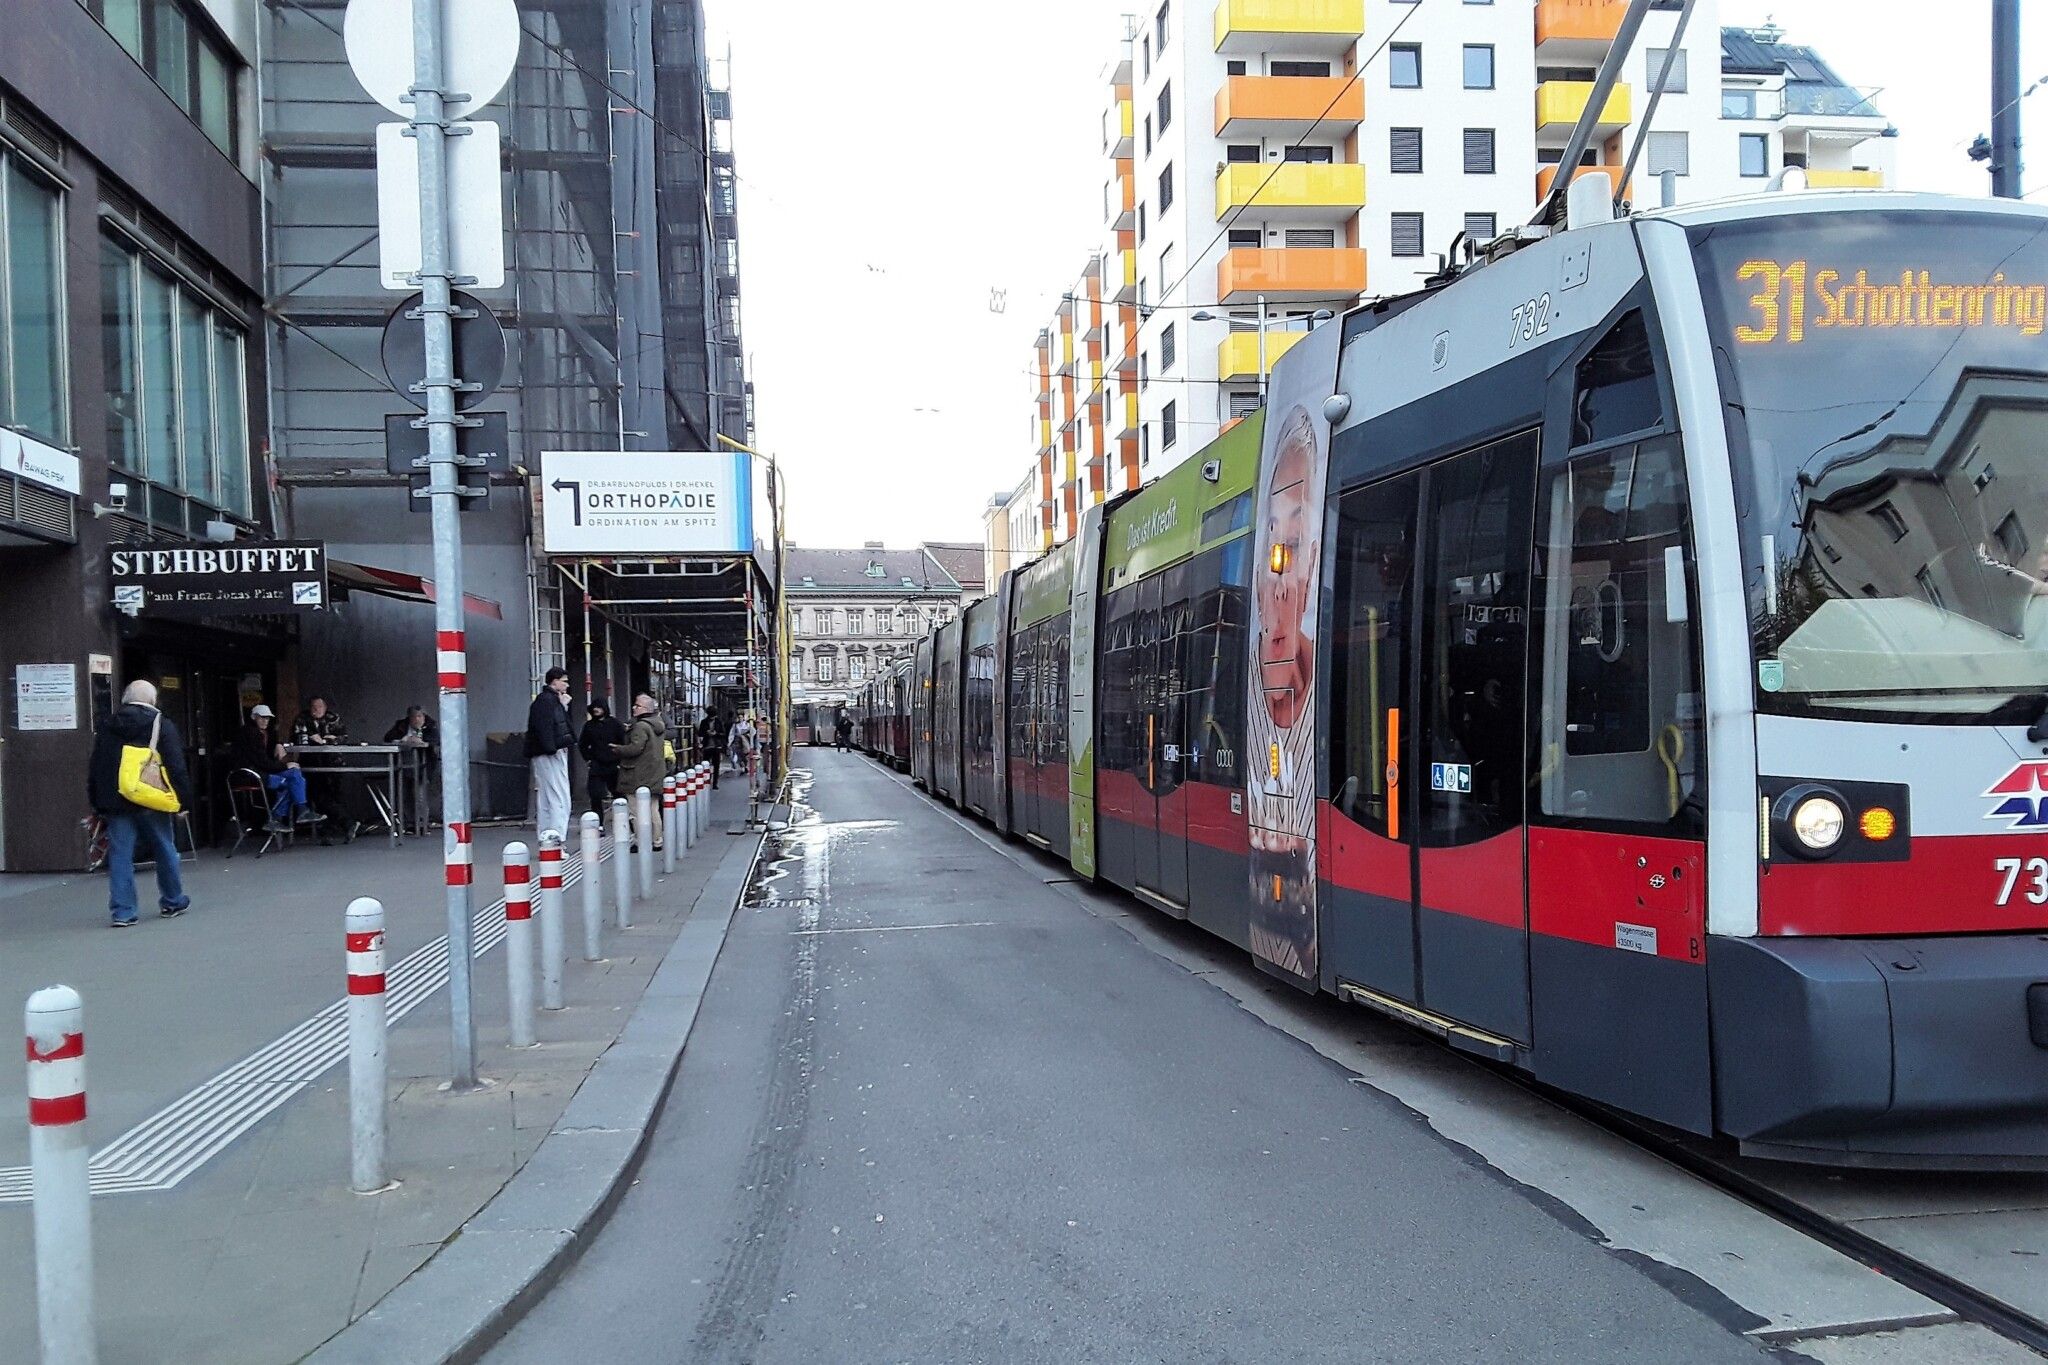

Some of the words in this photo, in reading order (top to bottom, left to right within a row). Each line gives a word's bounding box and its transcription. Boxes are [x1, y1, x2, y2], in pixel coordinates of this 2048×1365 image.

[1734, 259, 1806, 344] 31
[1813, 269, 2046, 336] Schottenring
[1509, 291, 1551, 349] 732
[588, 518, 658, 526] ORDINATION
[664, 518, 679, 526] AM
[685, 518, 716, 526] SPITZ
[112, 548, 319, 576] STEHBUFFET
[1995, 857, 2048, 906] 73
[1616, 924, 1654, 939] Wagenmasse
[1690, 937, 1699, 958] B
